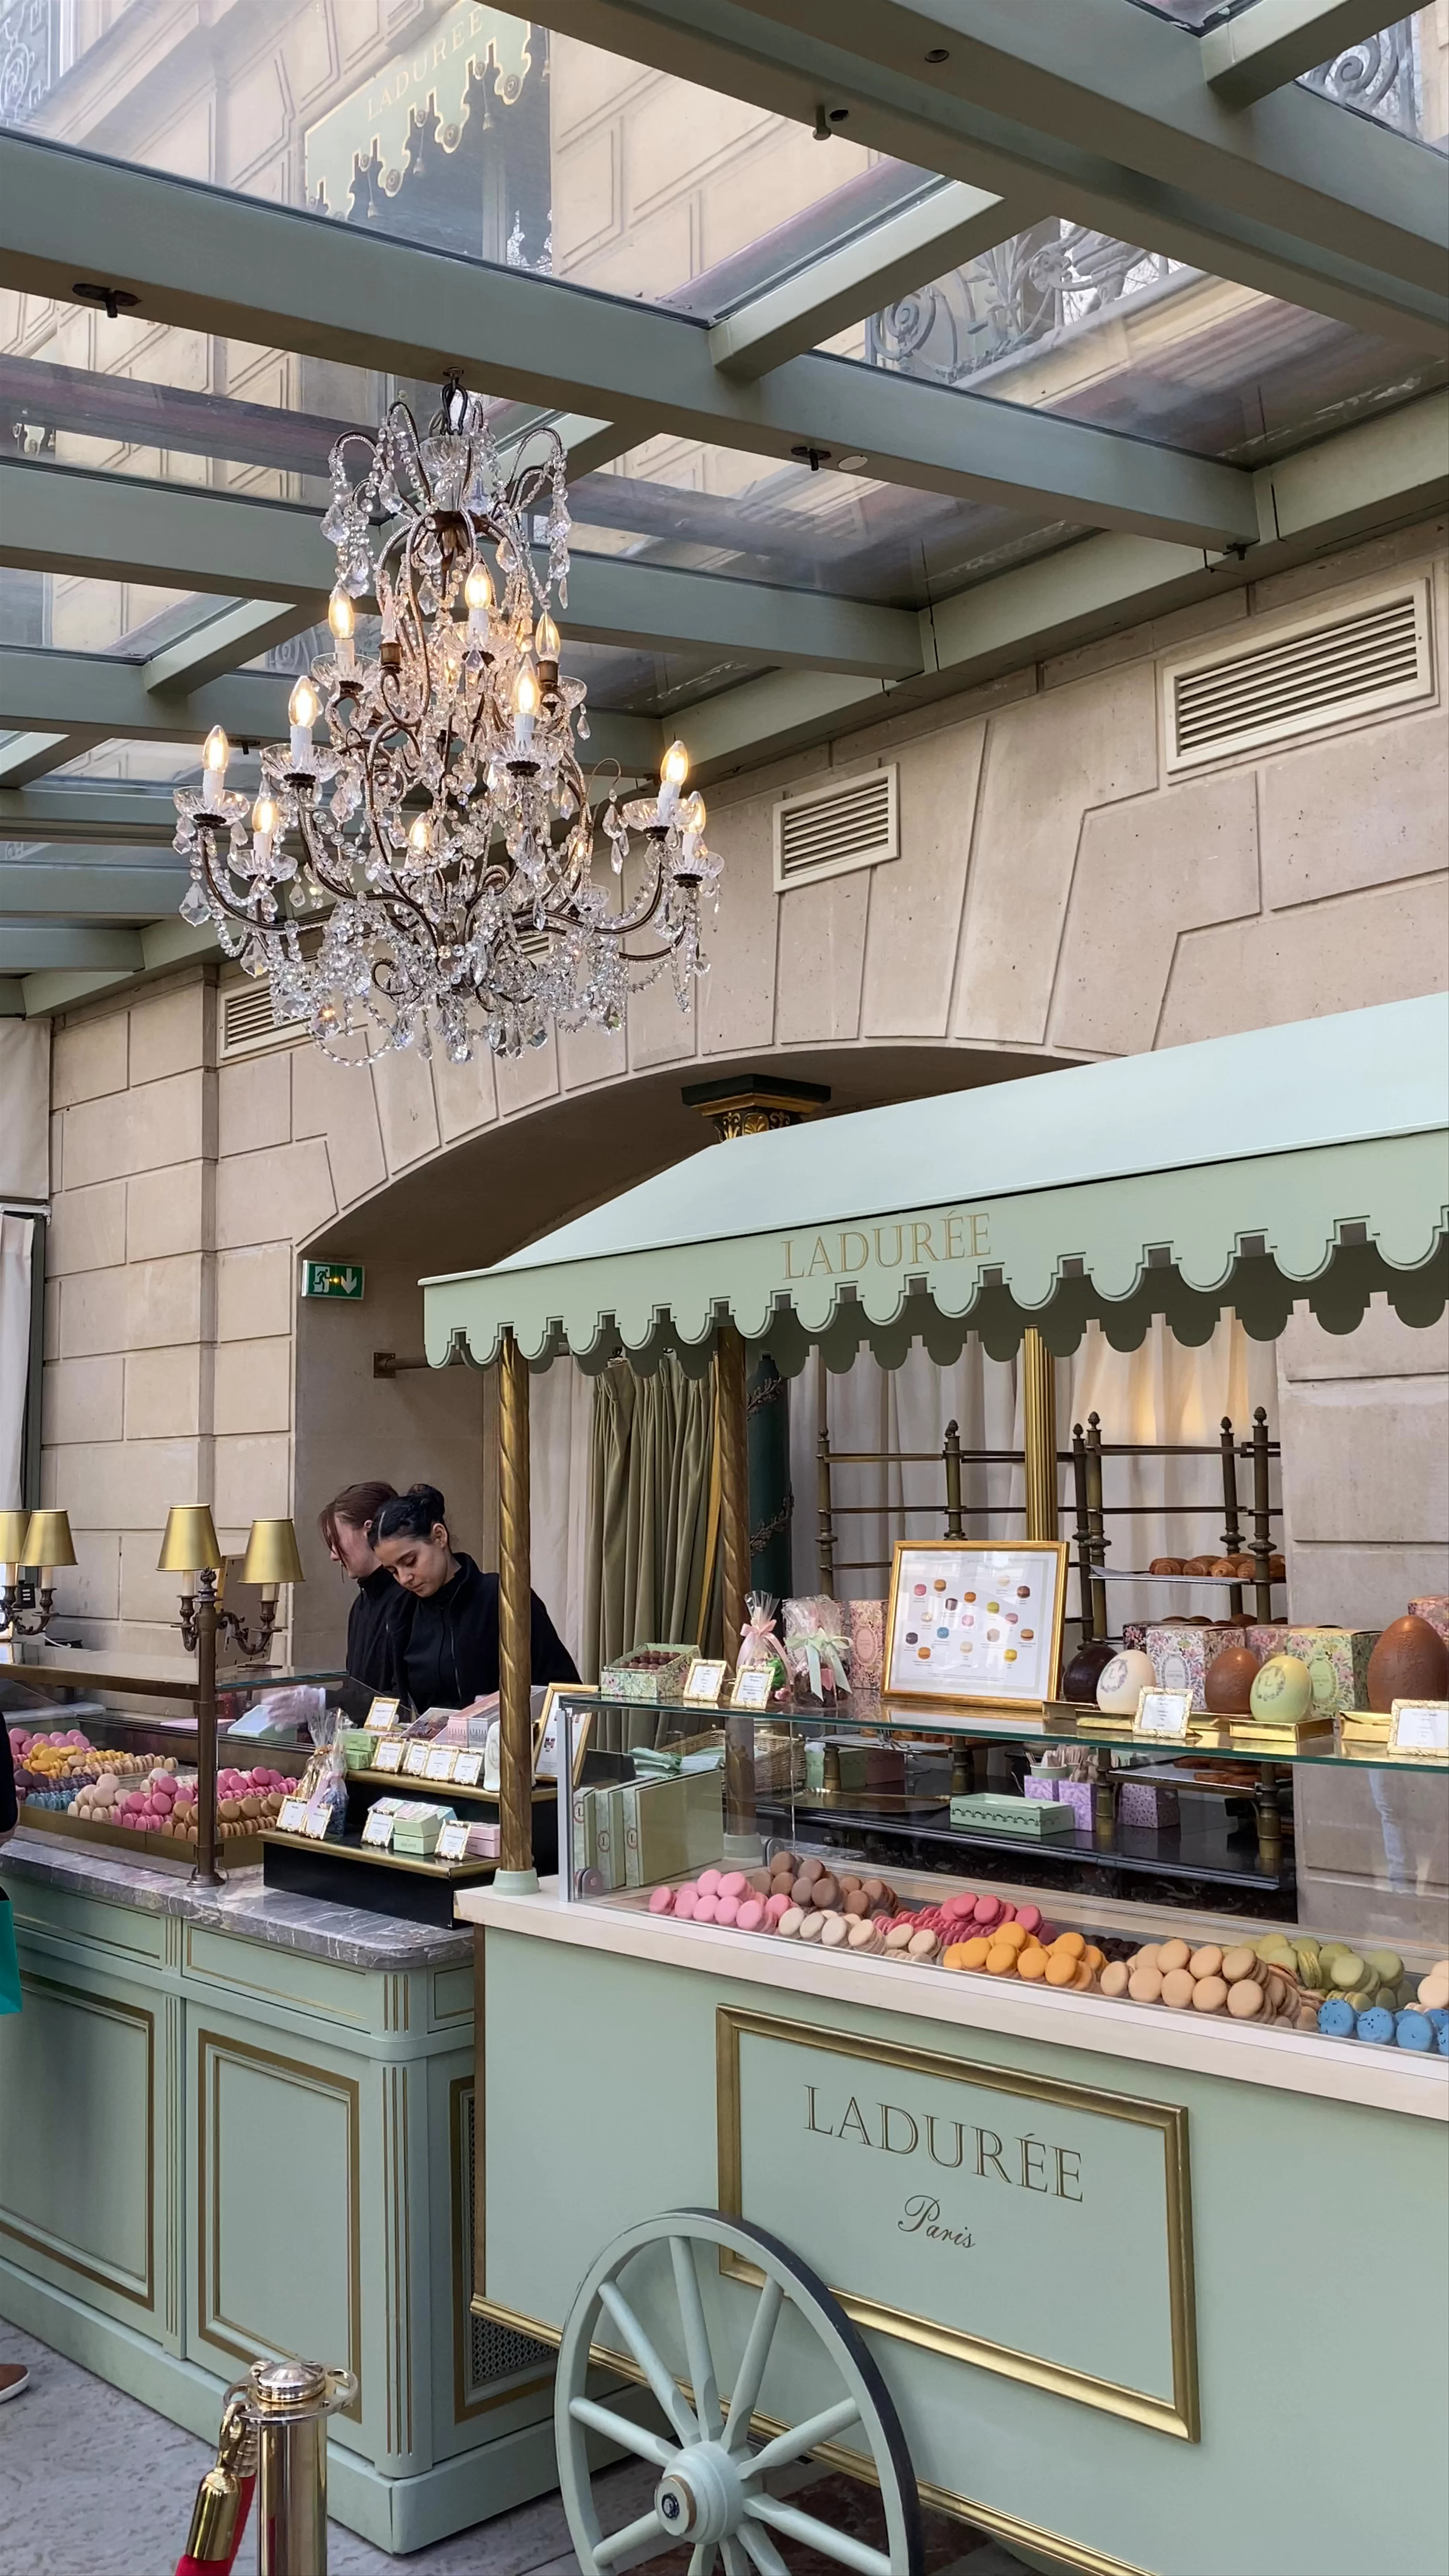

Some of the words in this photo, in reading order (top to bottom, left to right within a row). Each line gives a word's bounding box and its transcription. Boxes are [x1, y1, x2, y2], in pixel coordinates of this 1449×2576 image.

[780, 1210, 991, 1280] LADURÉE
[804, 2084, 1083, 2202] LADURÉE
[897, 2195, 976, 2248] Paris
